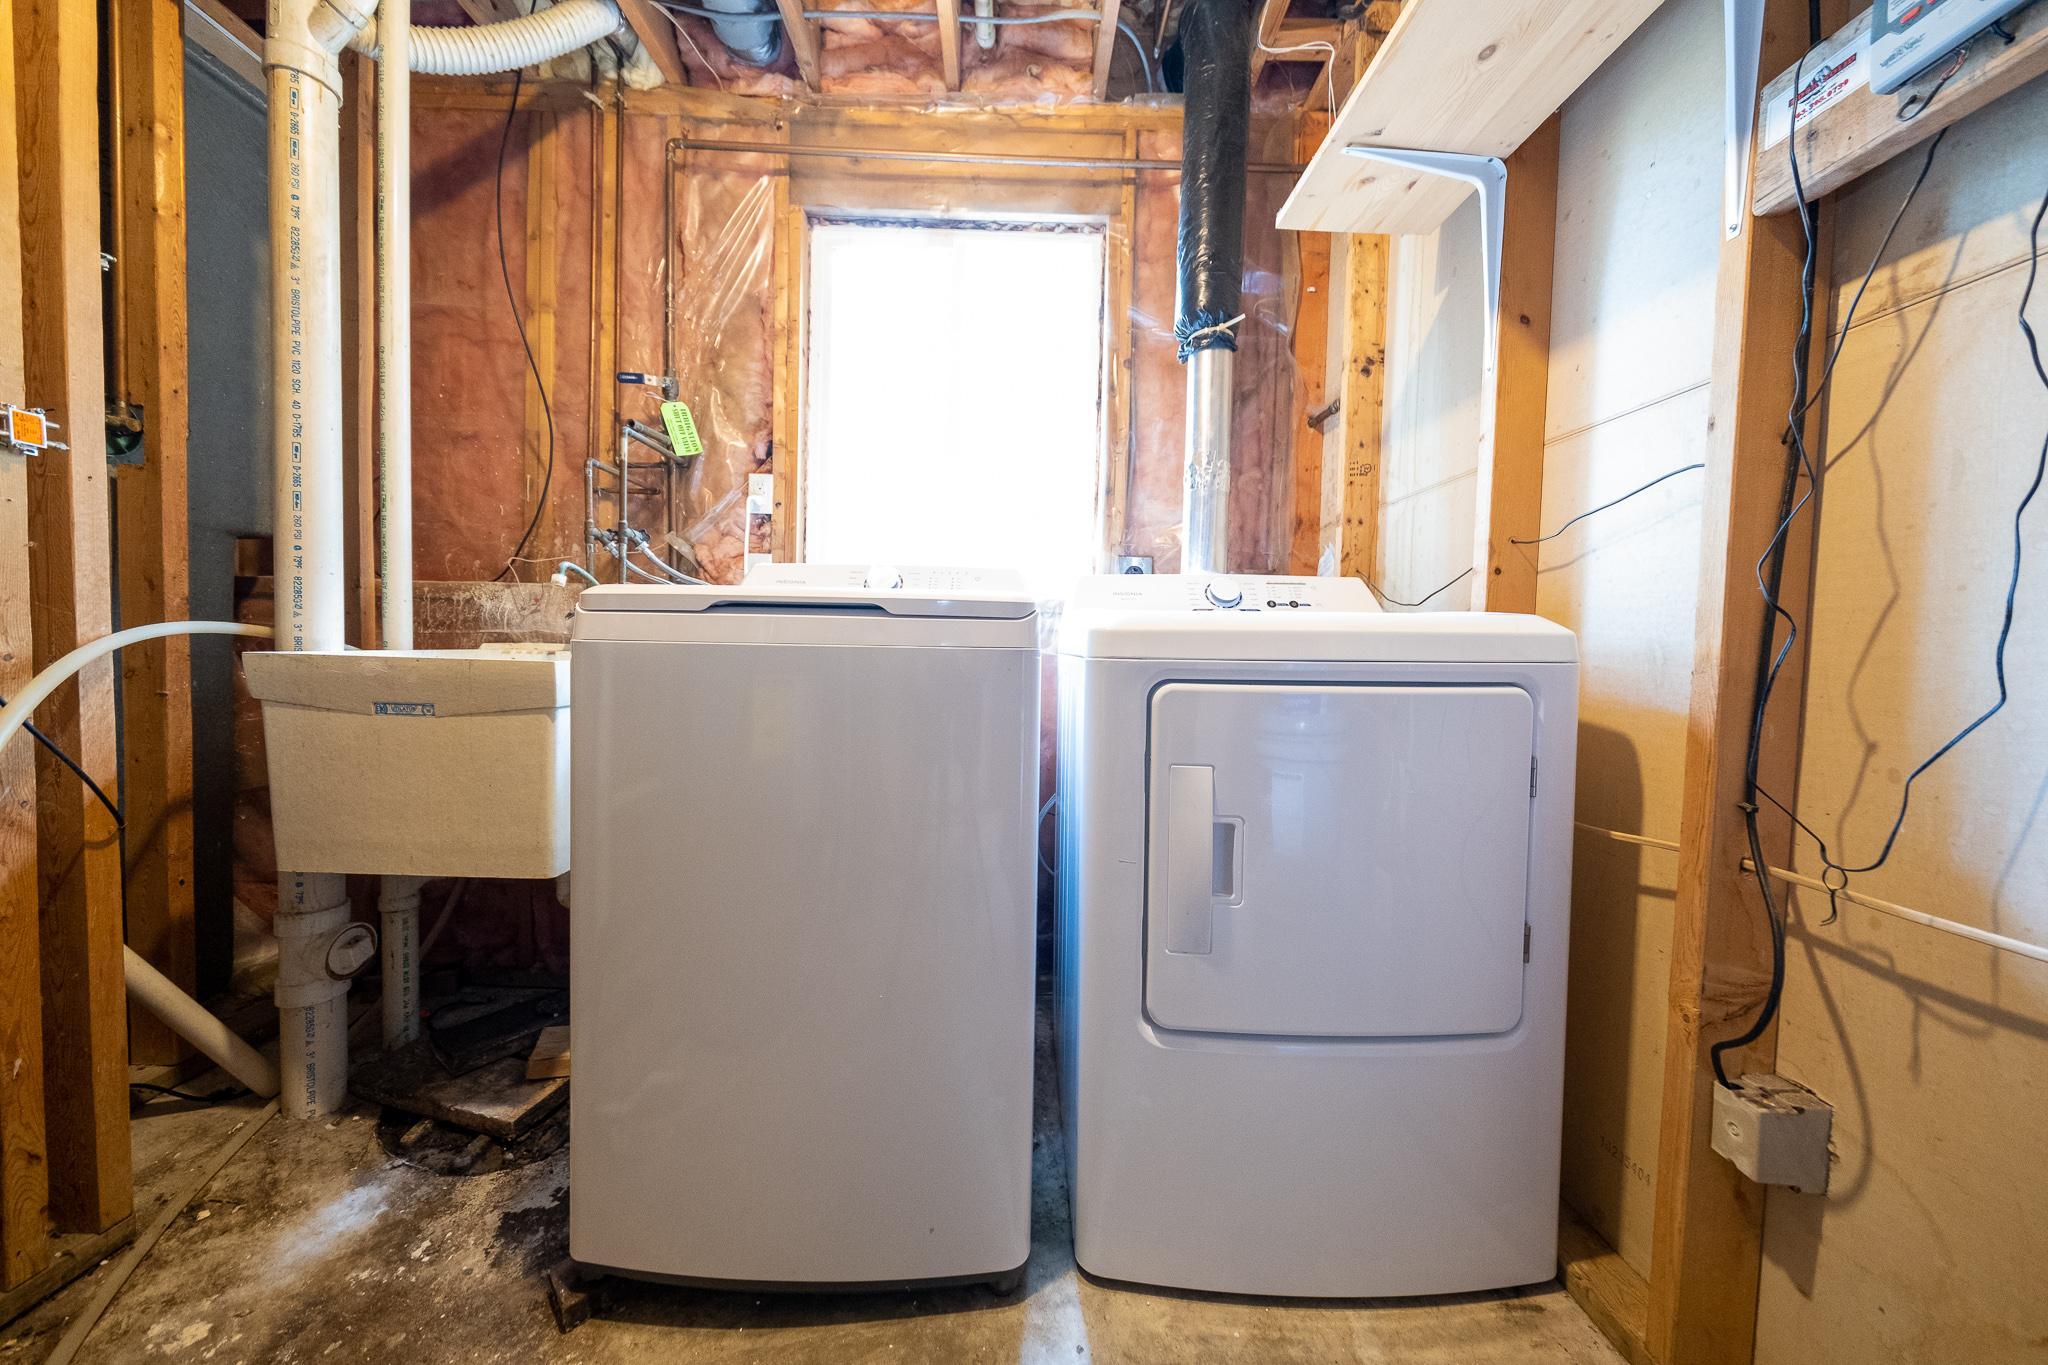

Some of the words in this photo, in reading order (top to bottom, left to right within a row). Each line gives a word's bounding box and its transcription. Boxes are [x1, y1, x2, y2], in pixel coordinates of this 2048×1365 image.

[292, 288, 301, 336] BRISTOLPIPE
[292, 340, 301, 356] PVC
[292, 359, 301, 375] 1120
[680, 408, 699, 452] IRRIGATION
